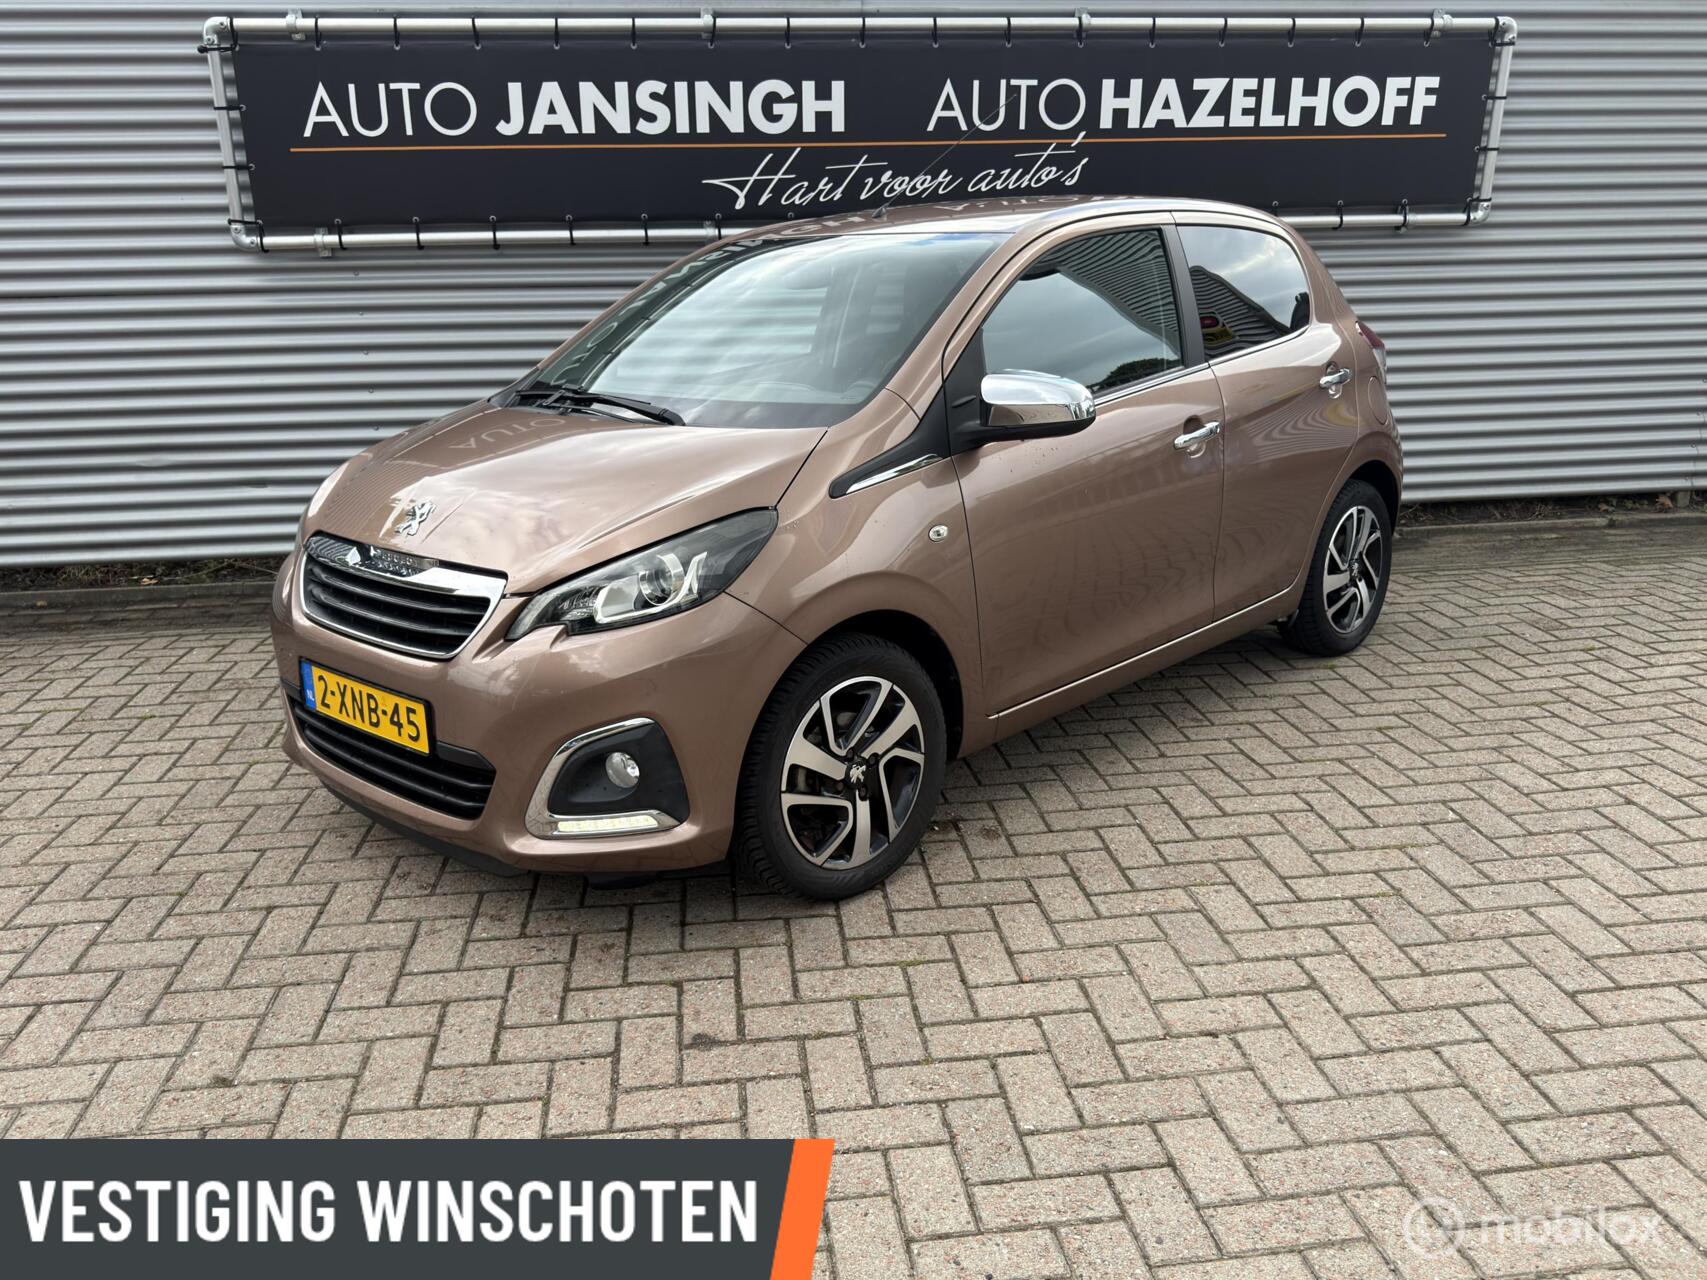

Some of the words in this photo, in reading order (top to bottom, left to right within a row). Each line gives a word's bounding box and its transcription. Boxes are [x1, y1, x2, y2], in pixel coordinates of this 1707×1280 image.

[303, 81, 478, 138] AUTO
[495, 79, 845, 136] JANSINGH
[926, 78, 1087, 132] AUTO
[1099, 75, 1441, 129] HAZELHOFF
[702, 147, 889, 210] Hart
[863, 170, 963, 200] voor
[967, 131, 1090, 193] auto's
[317, 674, 421, 743] 2-XNB-45
